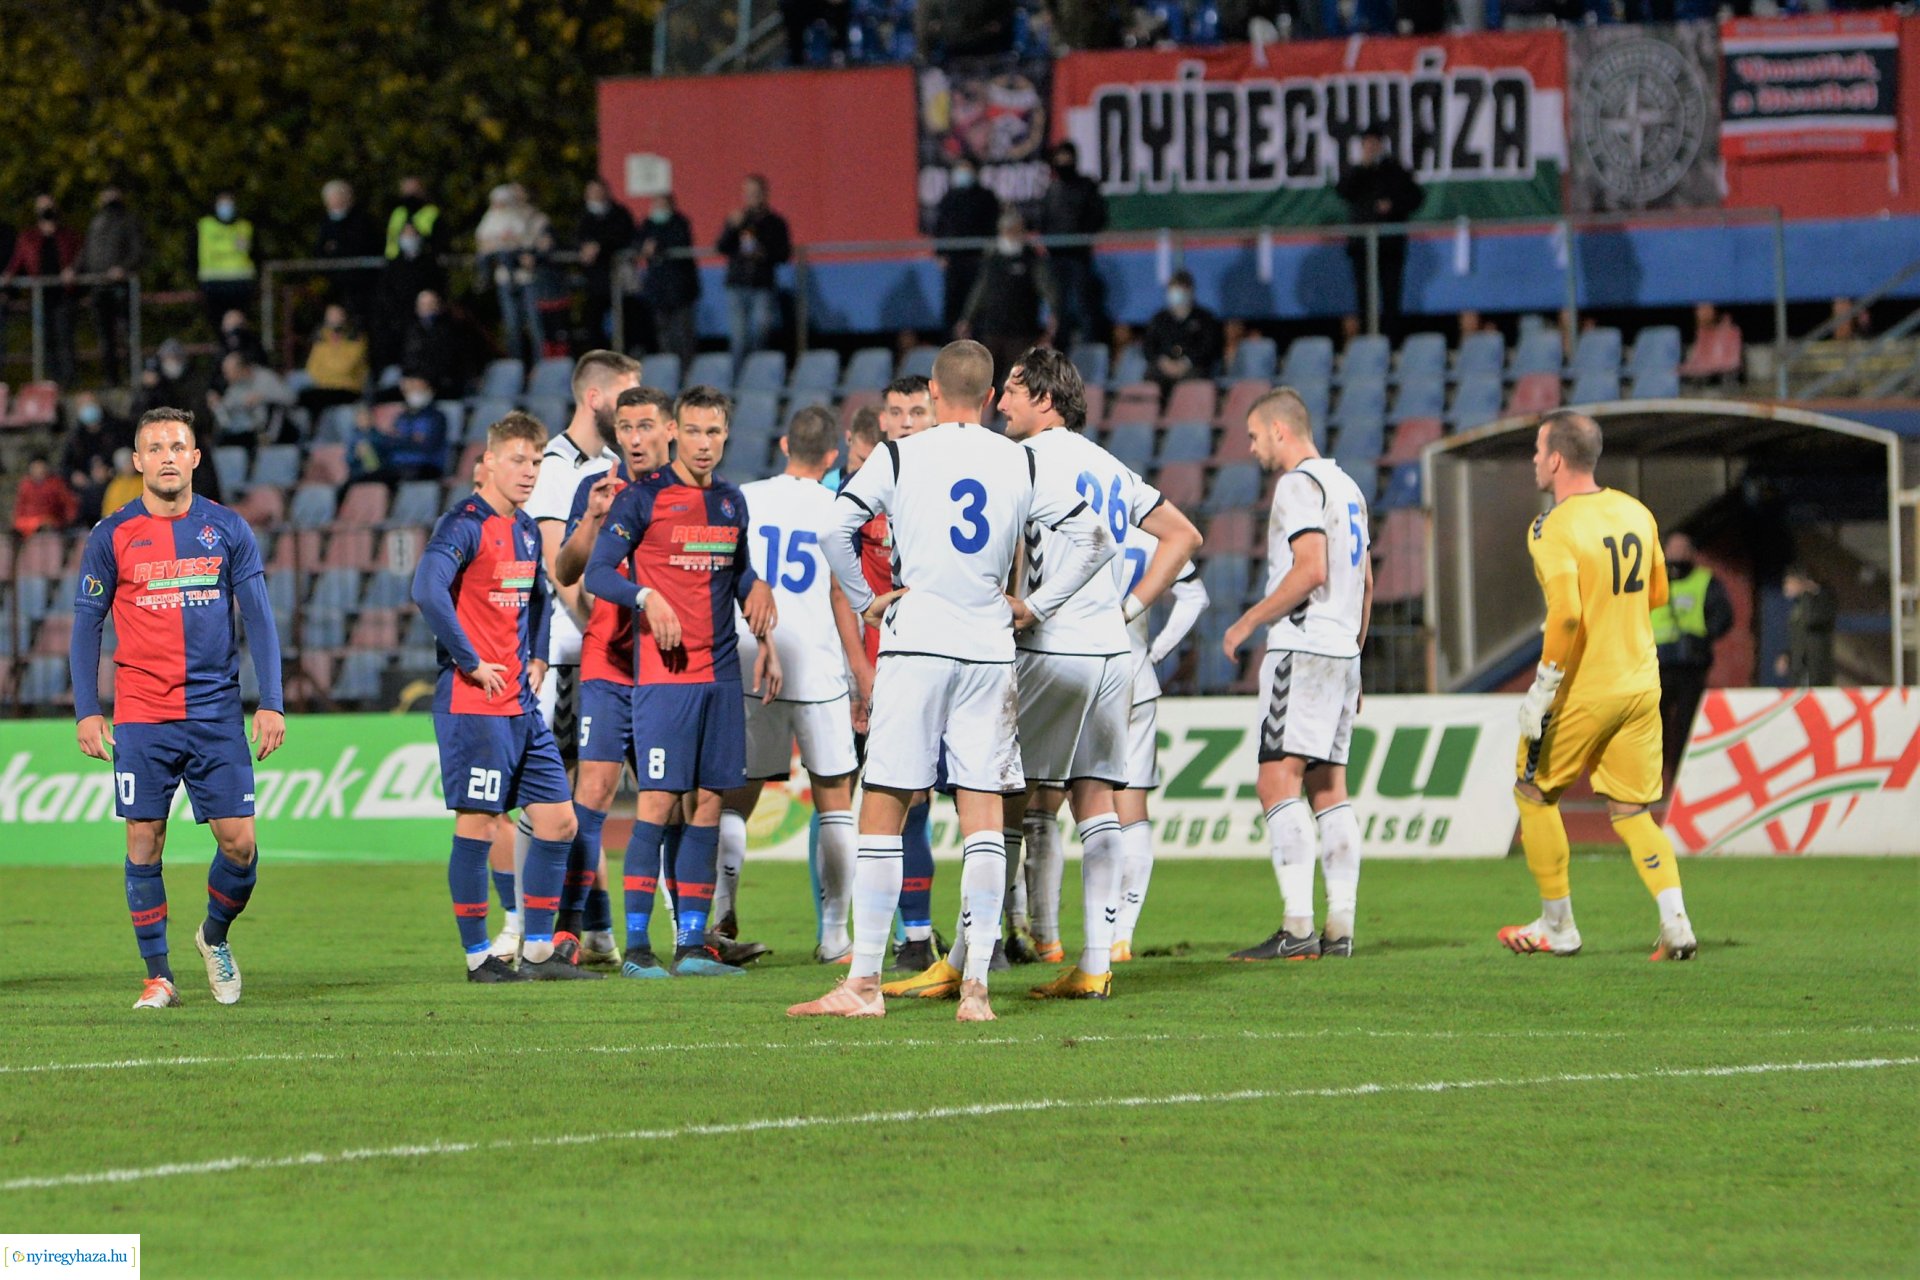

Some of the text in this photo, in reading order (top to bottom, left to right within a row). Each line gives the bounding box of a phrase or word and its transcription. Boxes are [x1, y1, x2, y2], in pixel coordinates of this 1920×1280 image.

[950, 478, 990, 554] 3
[1348, 501, 1363, 567] 5
[132, 556, 223, 583] REVESZ
[759, 525, 818, 594] 15
[1603, 532, 1645, 597] 12
[467, 767, 502, 802] 20
[649, 747, 665, 779] 8
